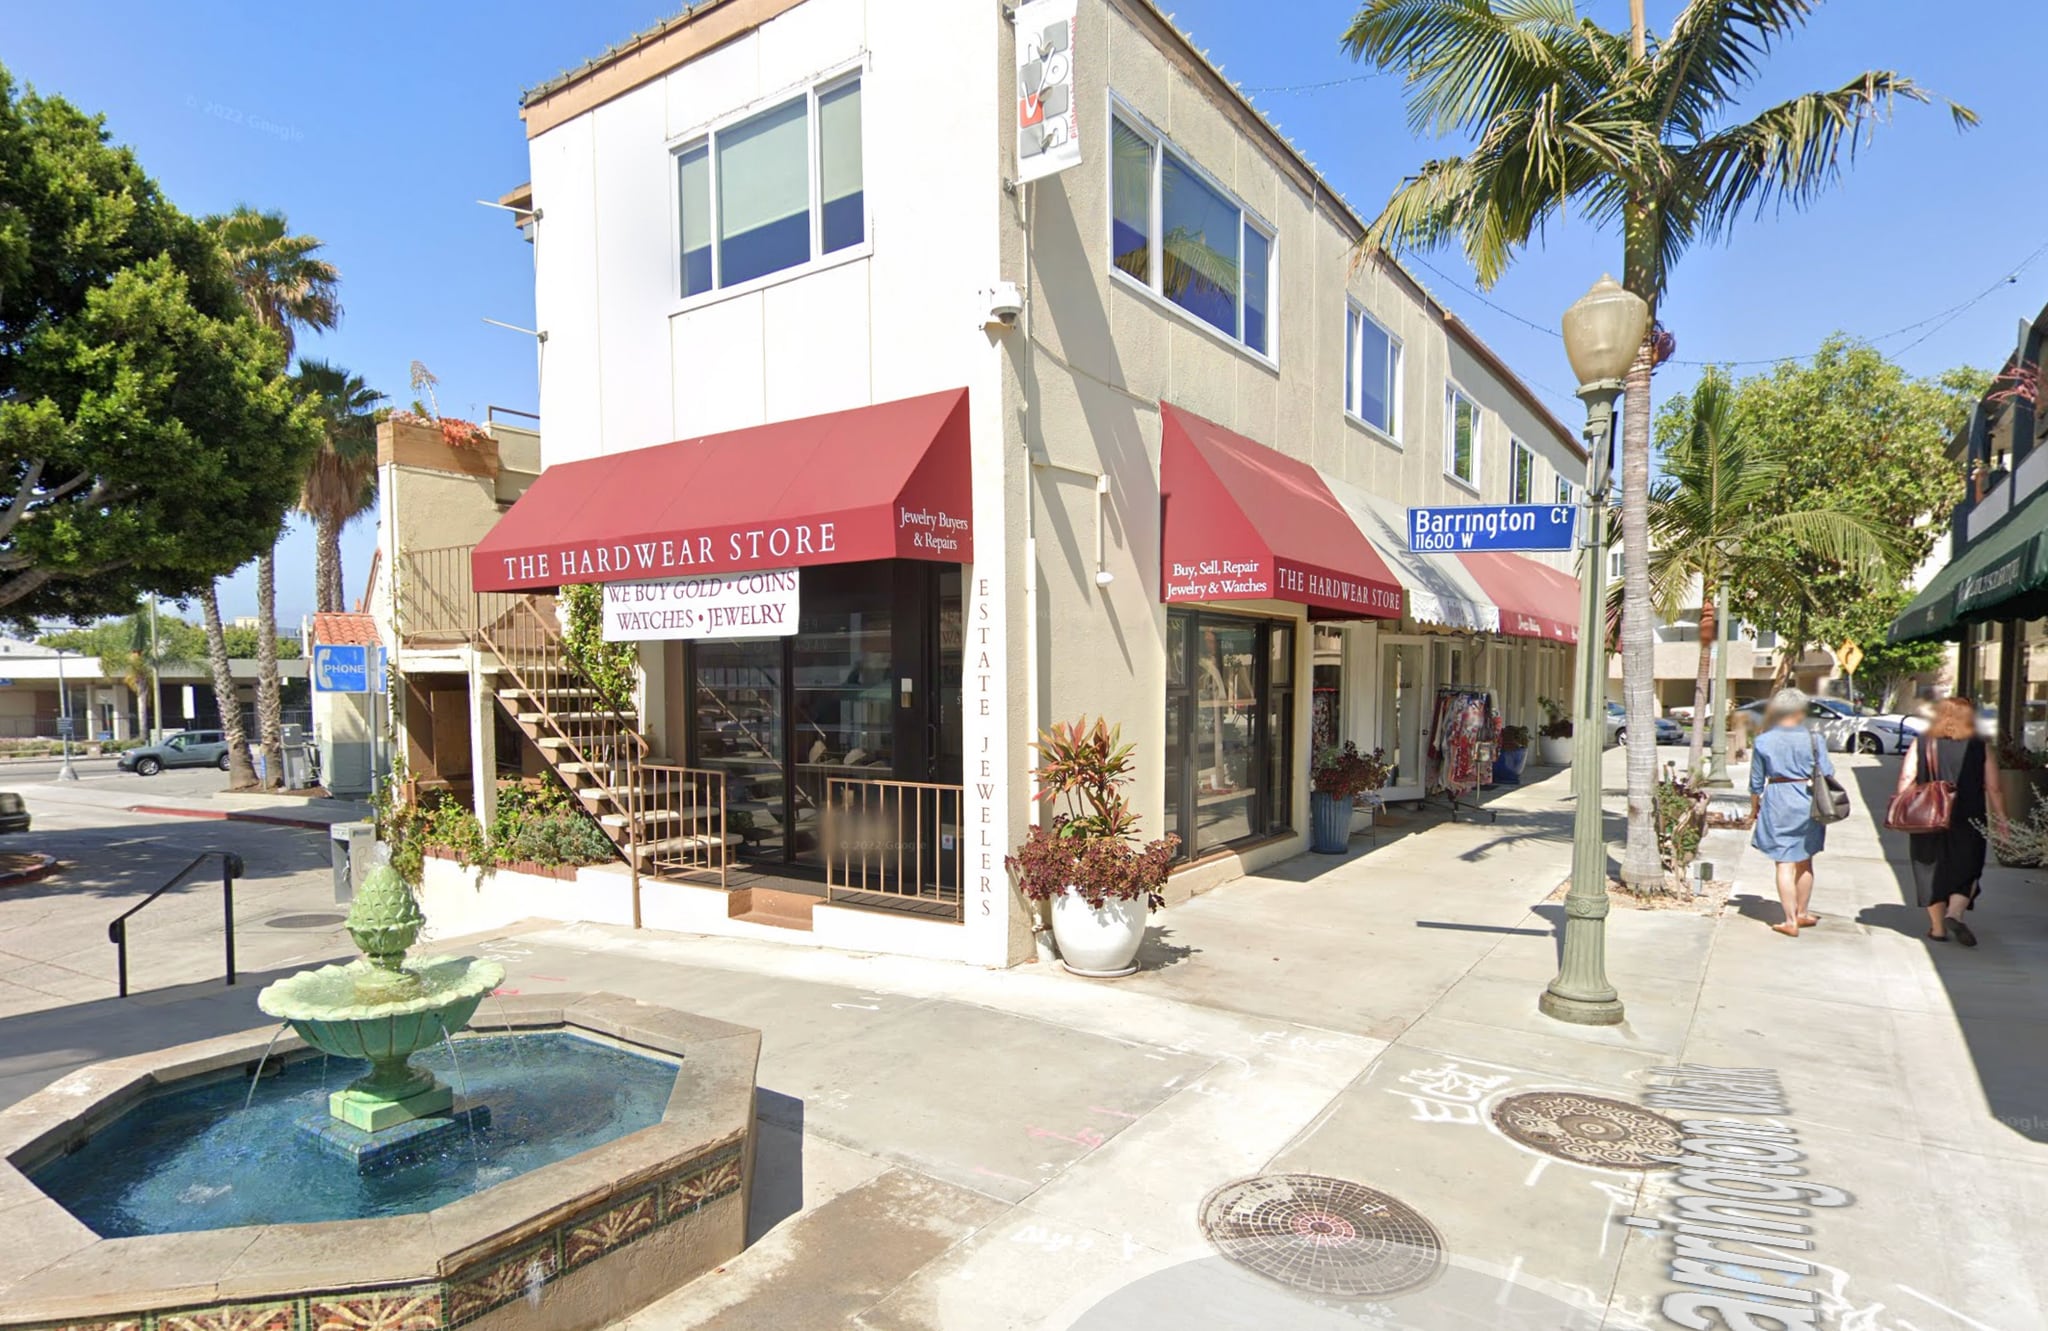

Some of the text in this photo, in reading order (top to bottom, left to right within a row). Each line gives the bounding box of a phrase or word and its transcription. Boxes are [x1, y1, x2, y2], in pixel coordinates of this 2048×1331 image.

[900, 507, 968, 533] Jewelry Buyers
[1415, 507, 1568, 539] Barrington Ct
[504, 522, 836, 582] THE HARDWEAR STORE
[913, 532, 958, 554] & Repairs
[1415, 533, 1474, 549] 11600 W
[1173, 560, 1260, 578] Buy, Sell, Repair
[607, 570, 797, 604] WE BUY GOLD COINS
[1166, 578, 1267, 600] Jewelry & Watches
[1278, 567, 1400, 610] THE HARDWEAR STORE
[616, 602, 787, 633] WATCHES JEWELRY
[324, 664, 366, 674] PHONE
[977, 578, 994, 916] ESTATE JEWELERS
